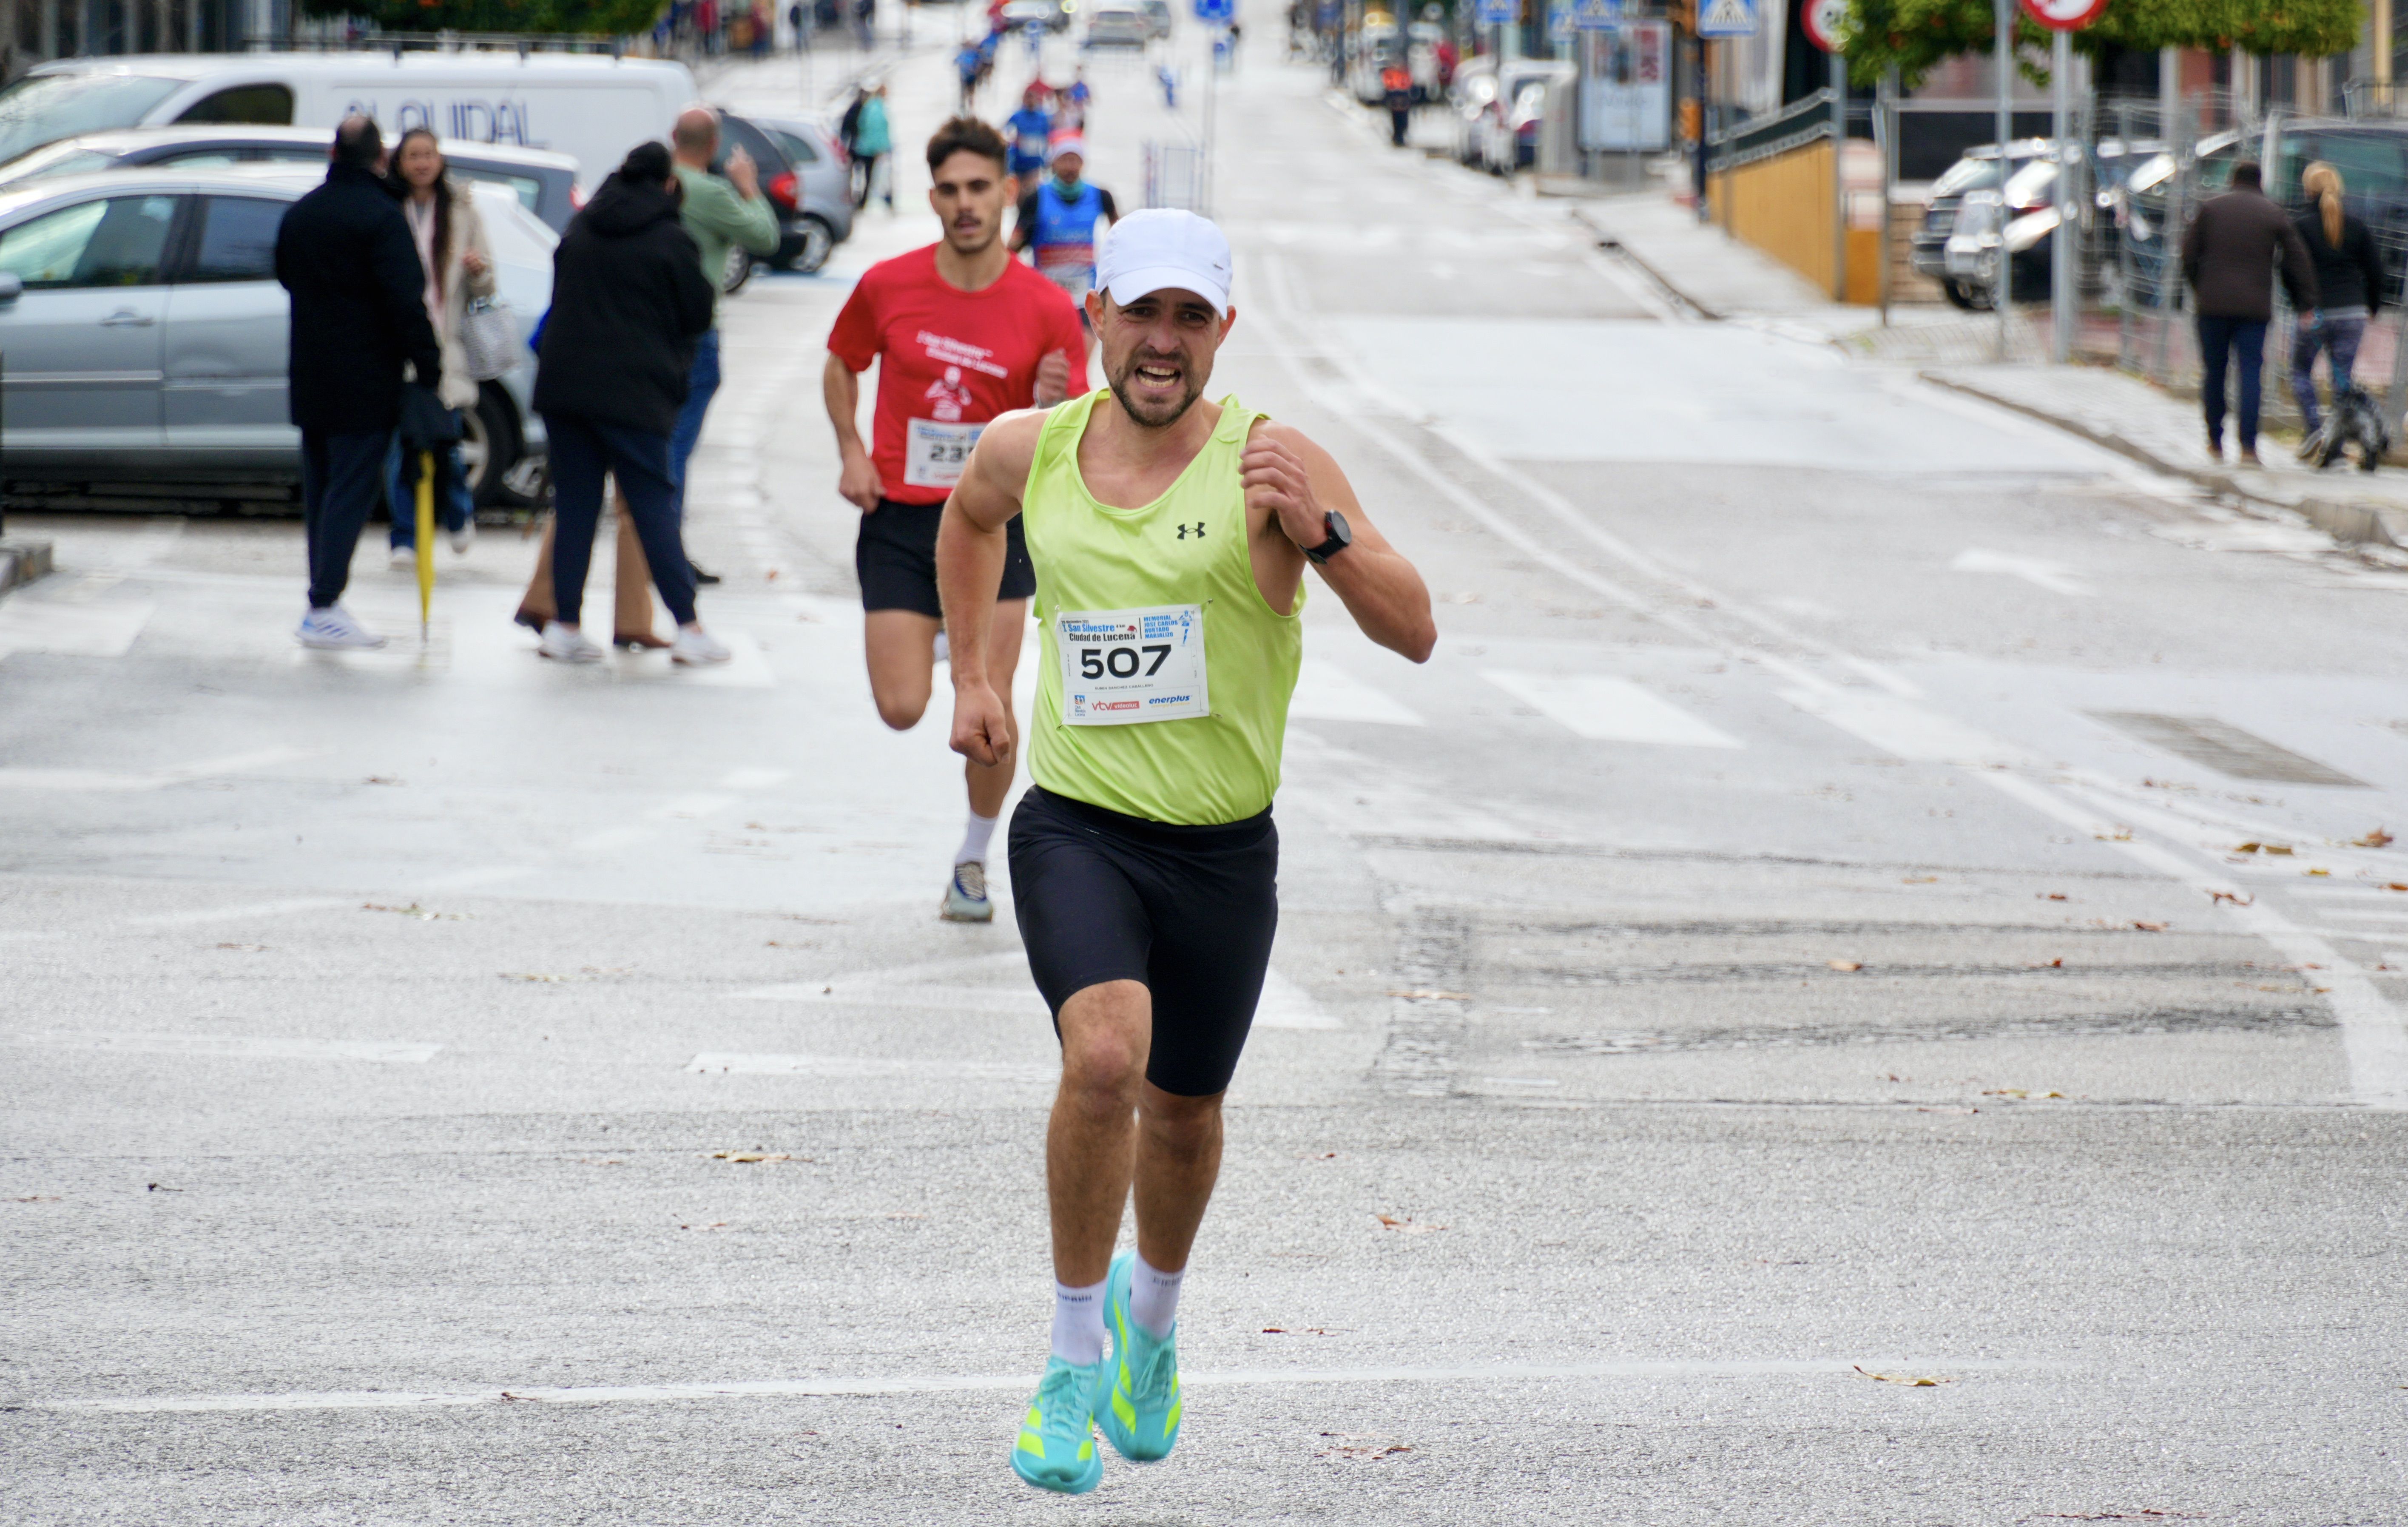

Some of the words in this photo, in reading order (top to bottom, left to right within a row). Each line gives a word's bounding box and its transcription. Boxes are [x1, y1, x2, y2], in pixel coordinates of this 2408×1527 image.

[930, 444, 975, 463] 23
[1068, 623, 1081, 632] San
[1082, 623, 1115, 632] Silvestre
[1069, 633, 1090, 642] Ciudad
[1092, 633, 1101, 642] de
[1103, 633, 1136, 641] Lucena
[1081, 644, 1172, 680] 507
[1149, 695, 1190, 704] enerplus
